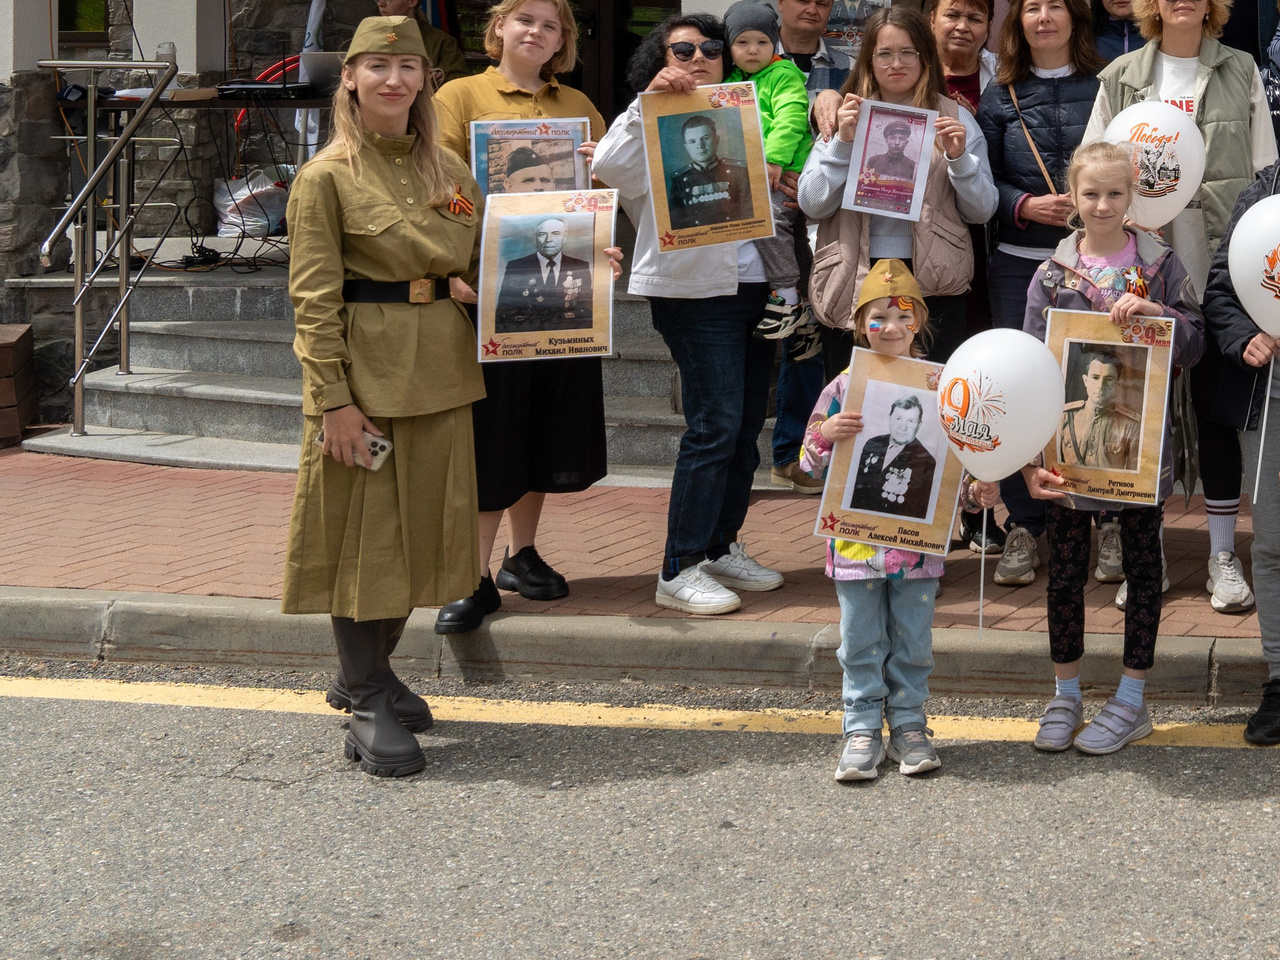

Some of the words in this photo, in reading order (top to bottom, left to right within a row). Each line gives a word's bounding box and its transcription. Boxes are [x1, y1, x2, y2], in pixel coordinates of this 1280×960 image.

[730, 91, 741, 107] 9
[1129, 123, 1180, 149] Победа!
[587, 194, 599, 212] 9
[678, 238, 697, 246] ПОЛК
[548, 336, 595, 347] Кузьминых
[1144, 326, 1156, 346] 9
[502, 348, 524, 357] ПОЛК
[535, 347, 567, 356] Михаил
[568, 344, 608, 355] Иванович
[946, 377, 971, 419] 9
[1108, 479, 1135, 489] Ретивов
[1087, 486, 1114, 495] Дмитрий
[1116, 489, 1156, 499] Дмитриевич
[839, 527, 860, 536] ПОЛК
[897, 526, 920, 537] Пасов
[867, 532, 898, 543] Алексей
[899, 537, 945, 551] Михайлович
